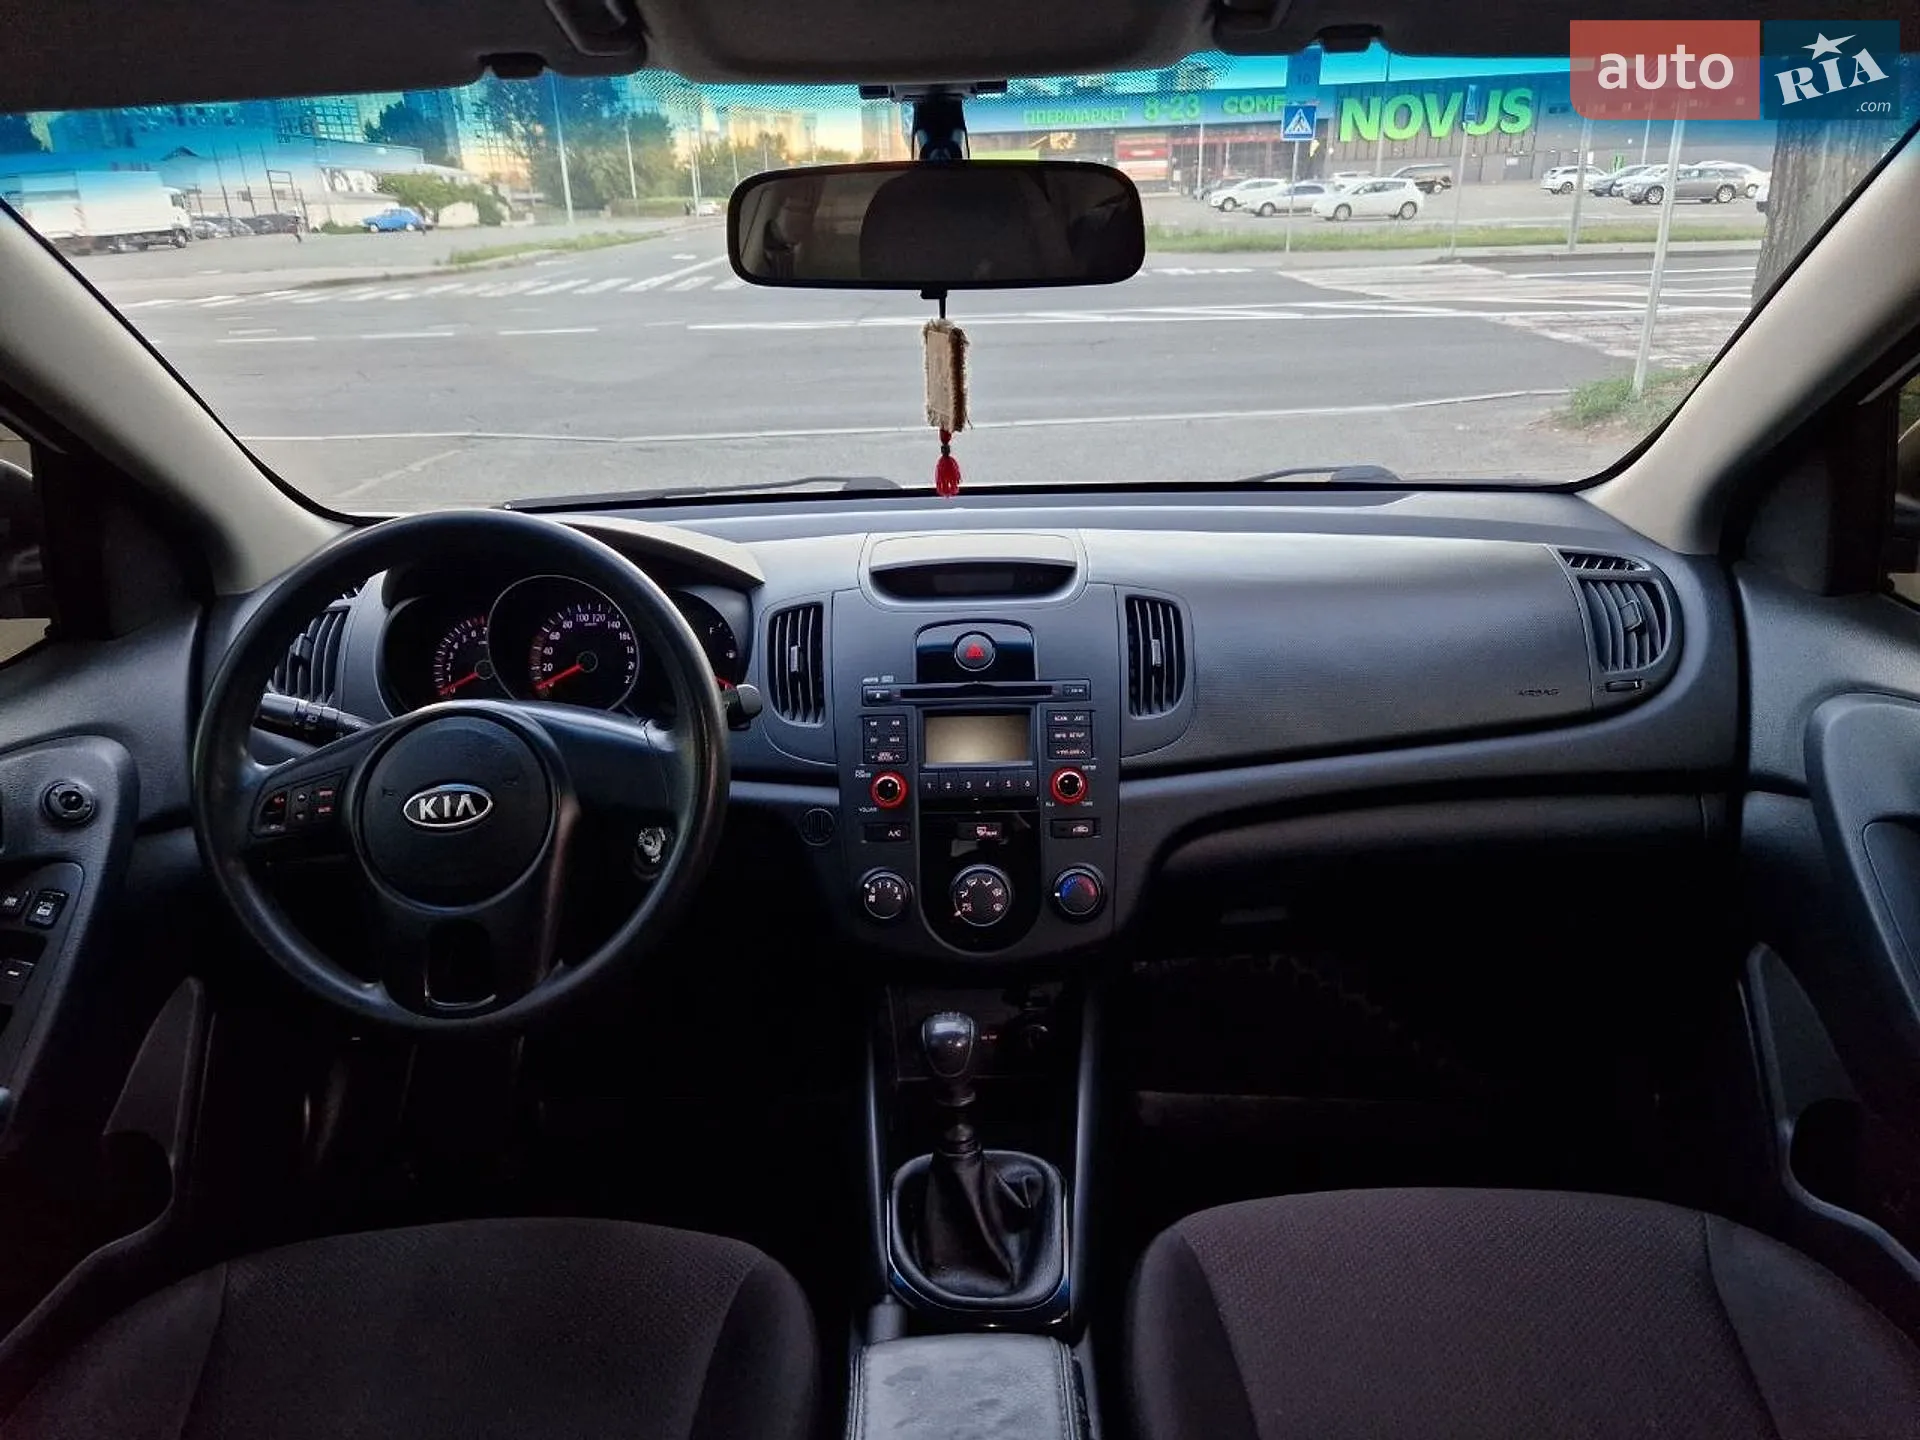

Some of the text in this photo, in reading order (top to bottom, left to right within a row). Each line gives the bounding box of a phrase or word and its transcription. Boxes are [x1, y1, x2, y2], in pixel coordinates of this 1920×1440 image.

[1143, 94, 1200, 121] 8-23
[1339, 87, 1534, 142] NOVUS
[576, 613, 590, 622] 100
[592, 613, 606, 622] 120
[562, 620, 573, 629] 80
[607, 620, 621, 629] 140
[542, 646, 554, 656] 40
[542, 662, 554, 672] 20
[966, 780, 972, 788] 3
[985, 780, 991, 788] 4
[1005, 779, 1012, 787] 5
[419, 794, 477, 820] KIA
[888, 829, 902, 837] A/C
